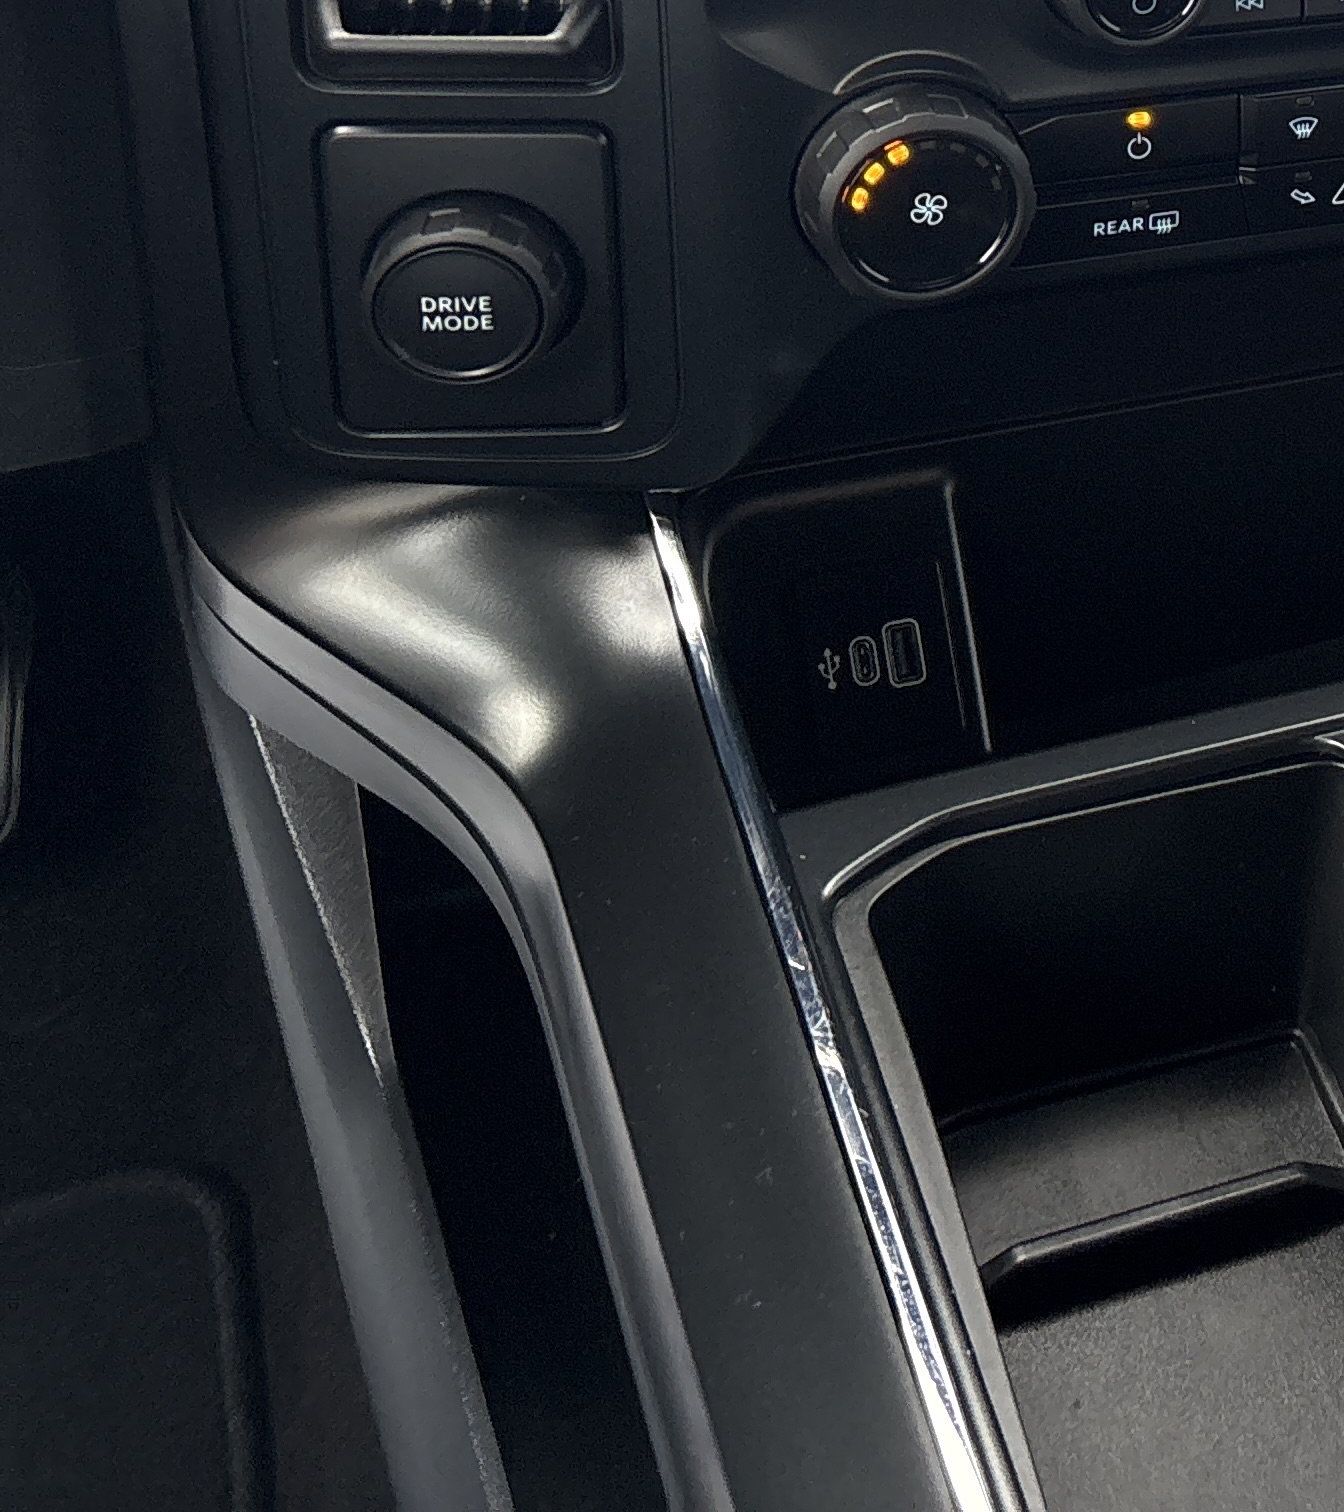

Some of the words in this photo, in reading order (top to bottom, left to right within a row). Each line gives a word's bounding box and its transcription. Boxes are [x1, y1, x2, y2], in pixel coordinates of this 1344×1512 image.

[1093, 216, 1144, 237] REAR
[420, 295, 492, 313] DRIVE
[422, 314, 494, 332] MODE
